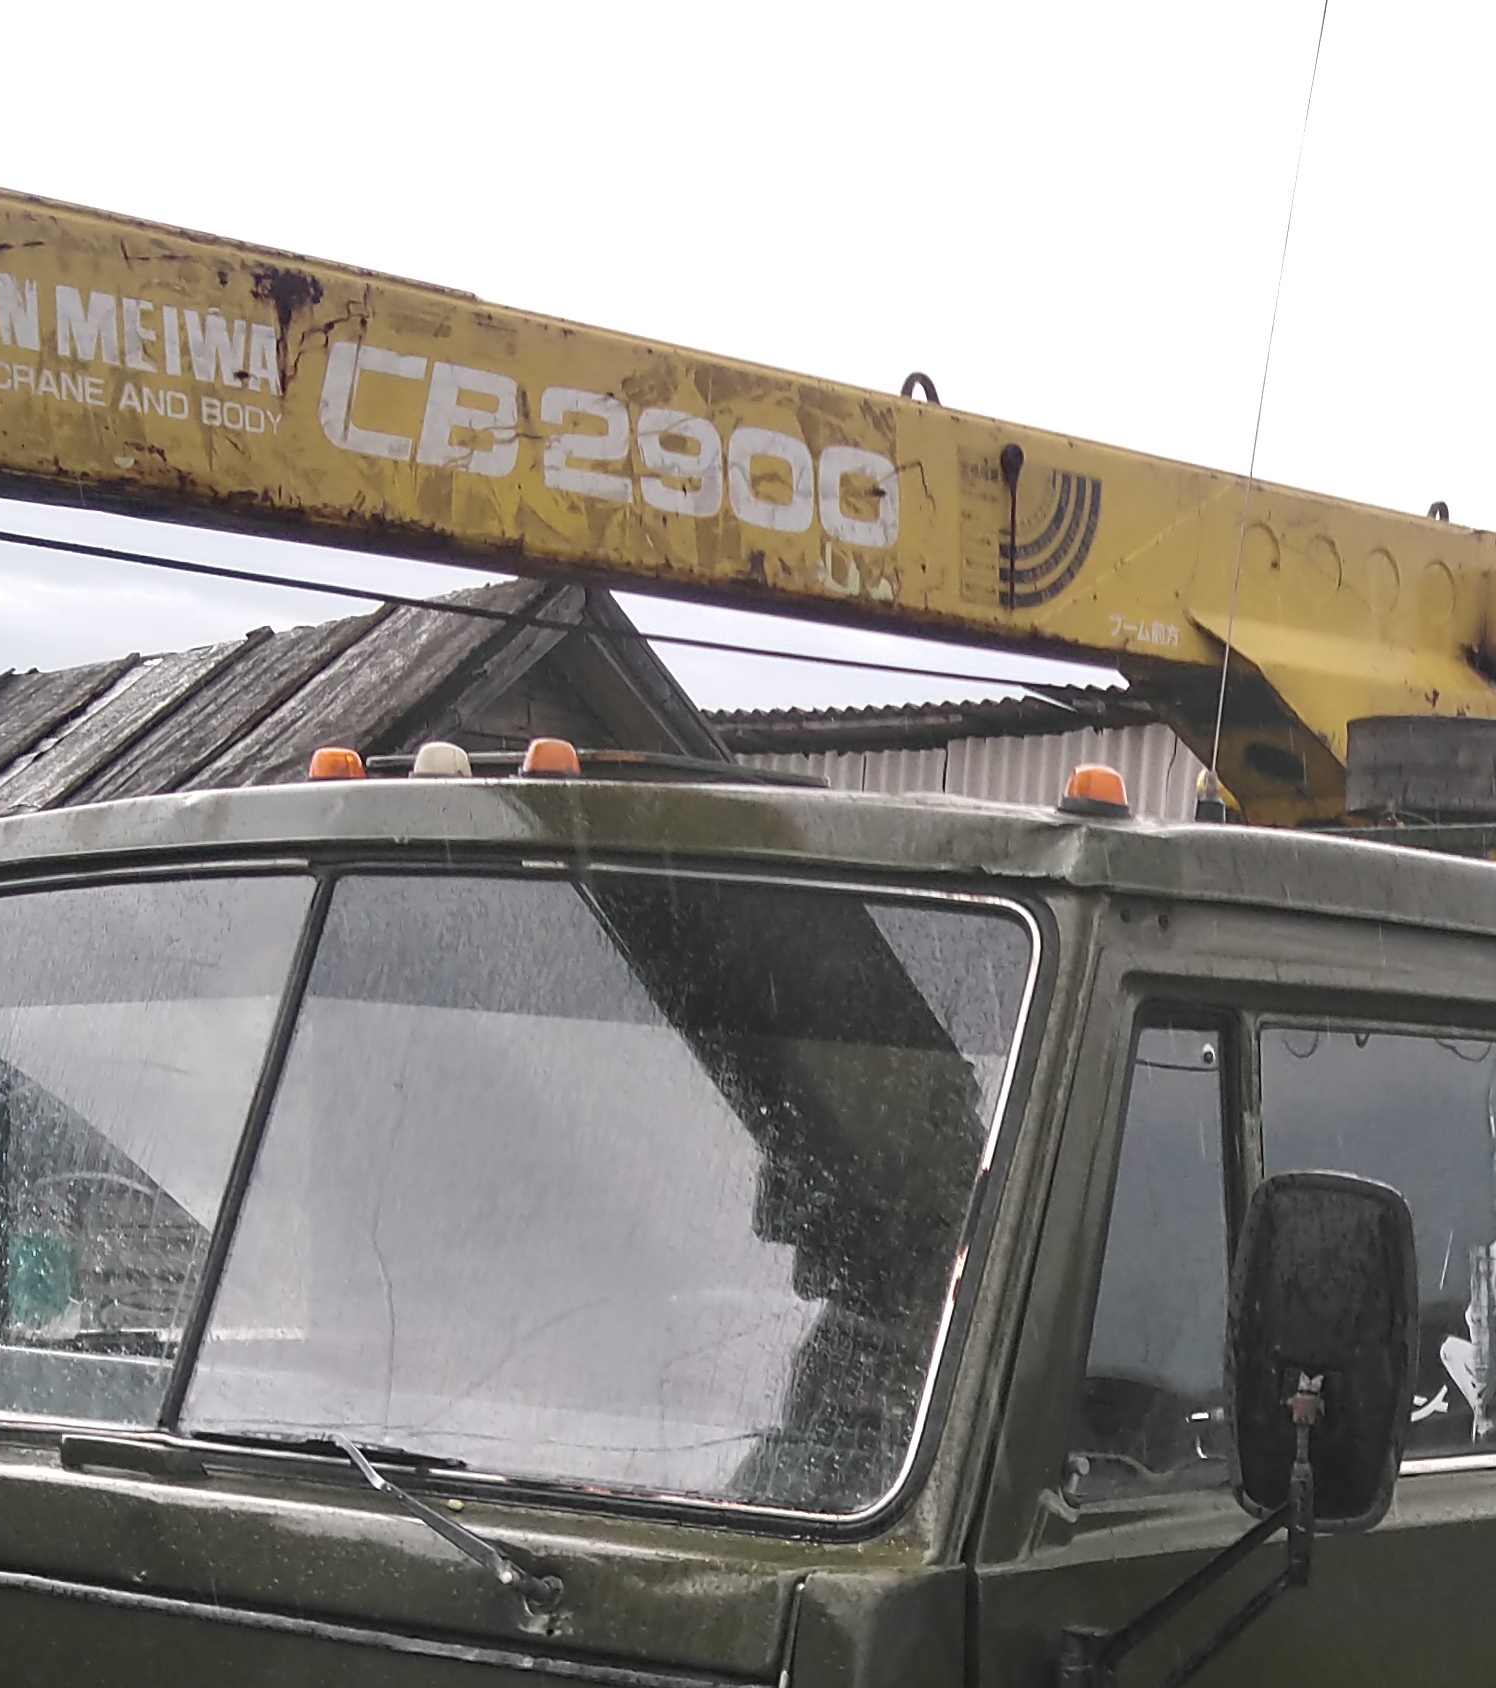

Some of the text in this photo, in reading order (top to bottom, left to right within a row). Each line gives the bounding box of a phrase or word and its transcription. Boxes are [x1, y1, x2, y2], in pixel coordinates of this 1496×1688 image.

[55, 285, 281, 396] MEIWA
[119, 383, 189, 421] AND
[203, 396, 282, 436] BODY
